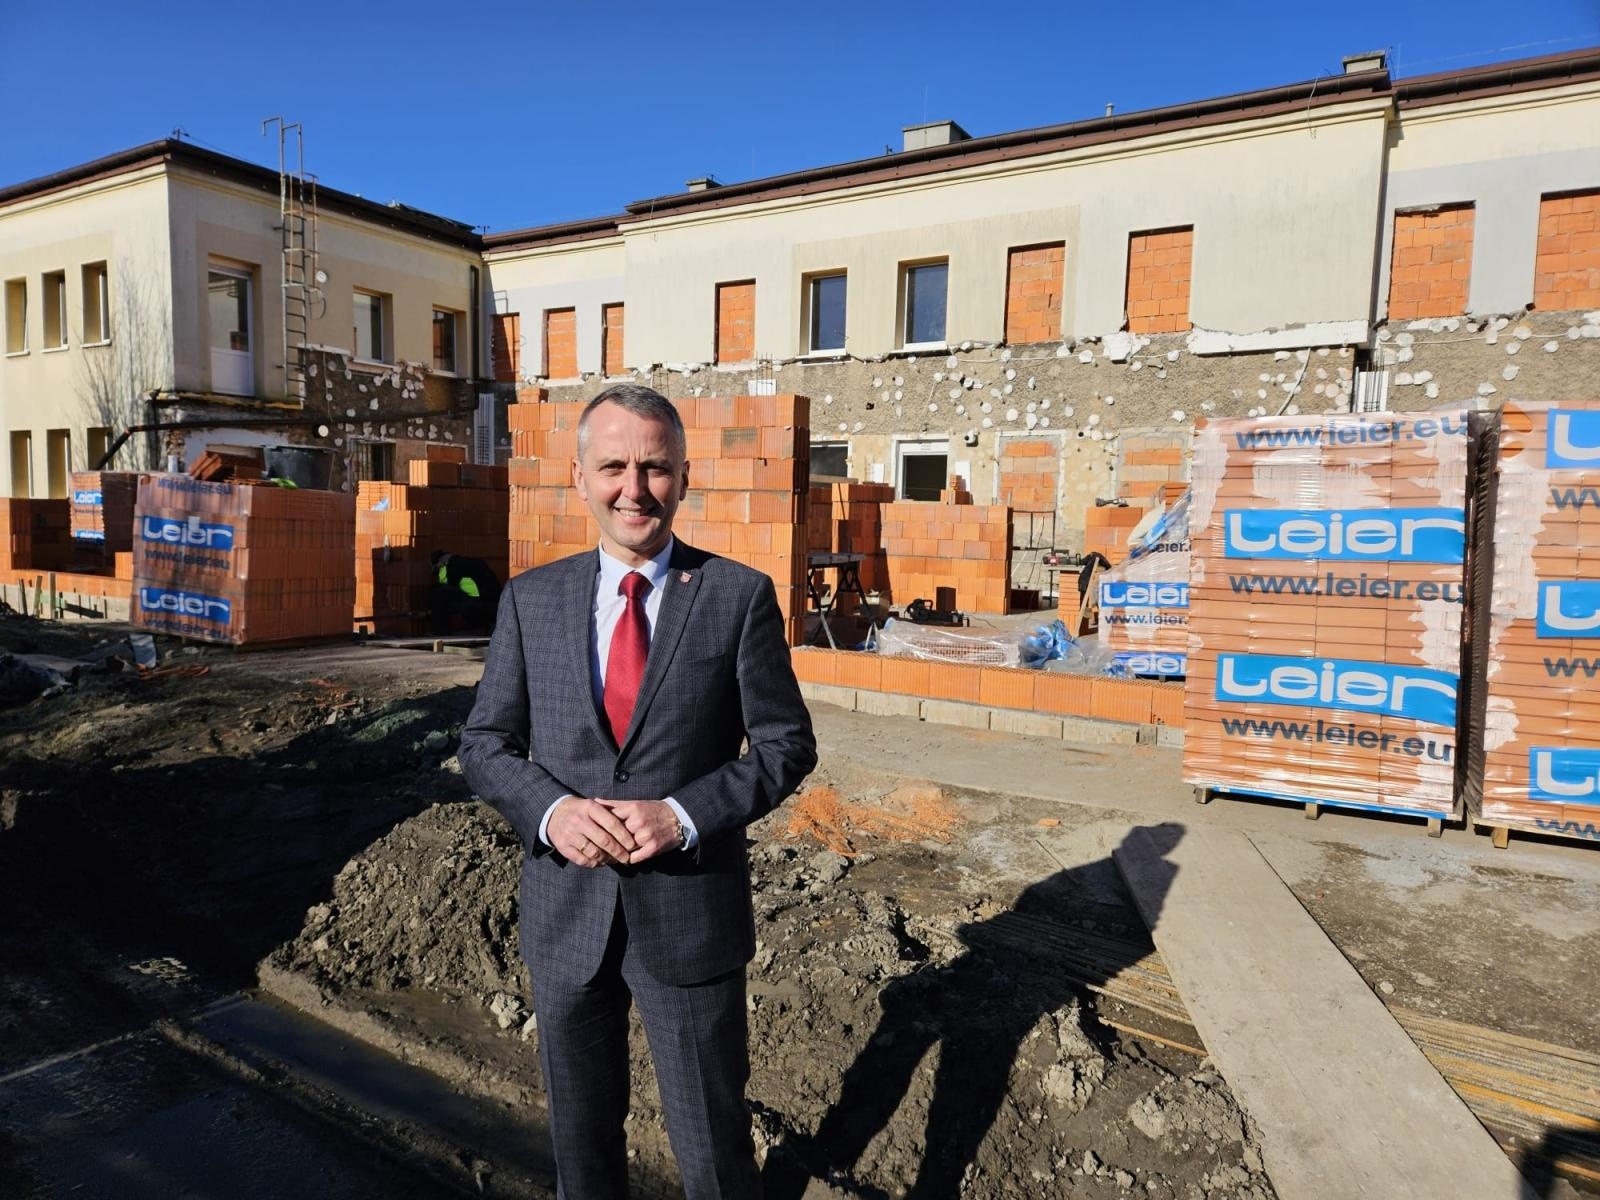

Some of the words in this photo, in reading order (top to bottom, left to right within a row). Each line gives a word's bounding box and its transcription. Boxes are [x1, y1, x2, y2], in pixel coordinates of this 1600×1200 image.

[1235, 413, 1467, 449] www.leier.eu
[144, 517, 233, 546] Leier
[1230, 513, 1464, 555] Leier
[142, 589, 230, 616] Leier
[1229, 572, 1464, 604] www.leier.eu
[1222, 658, 1456, 711] Leier
[1222, 718, 1452, 763] www.leier.eu
